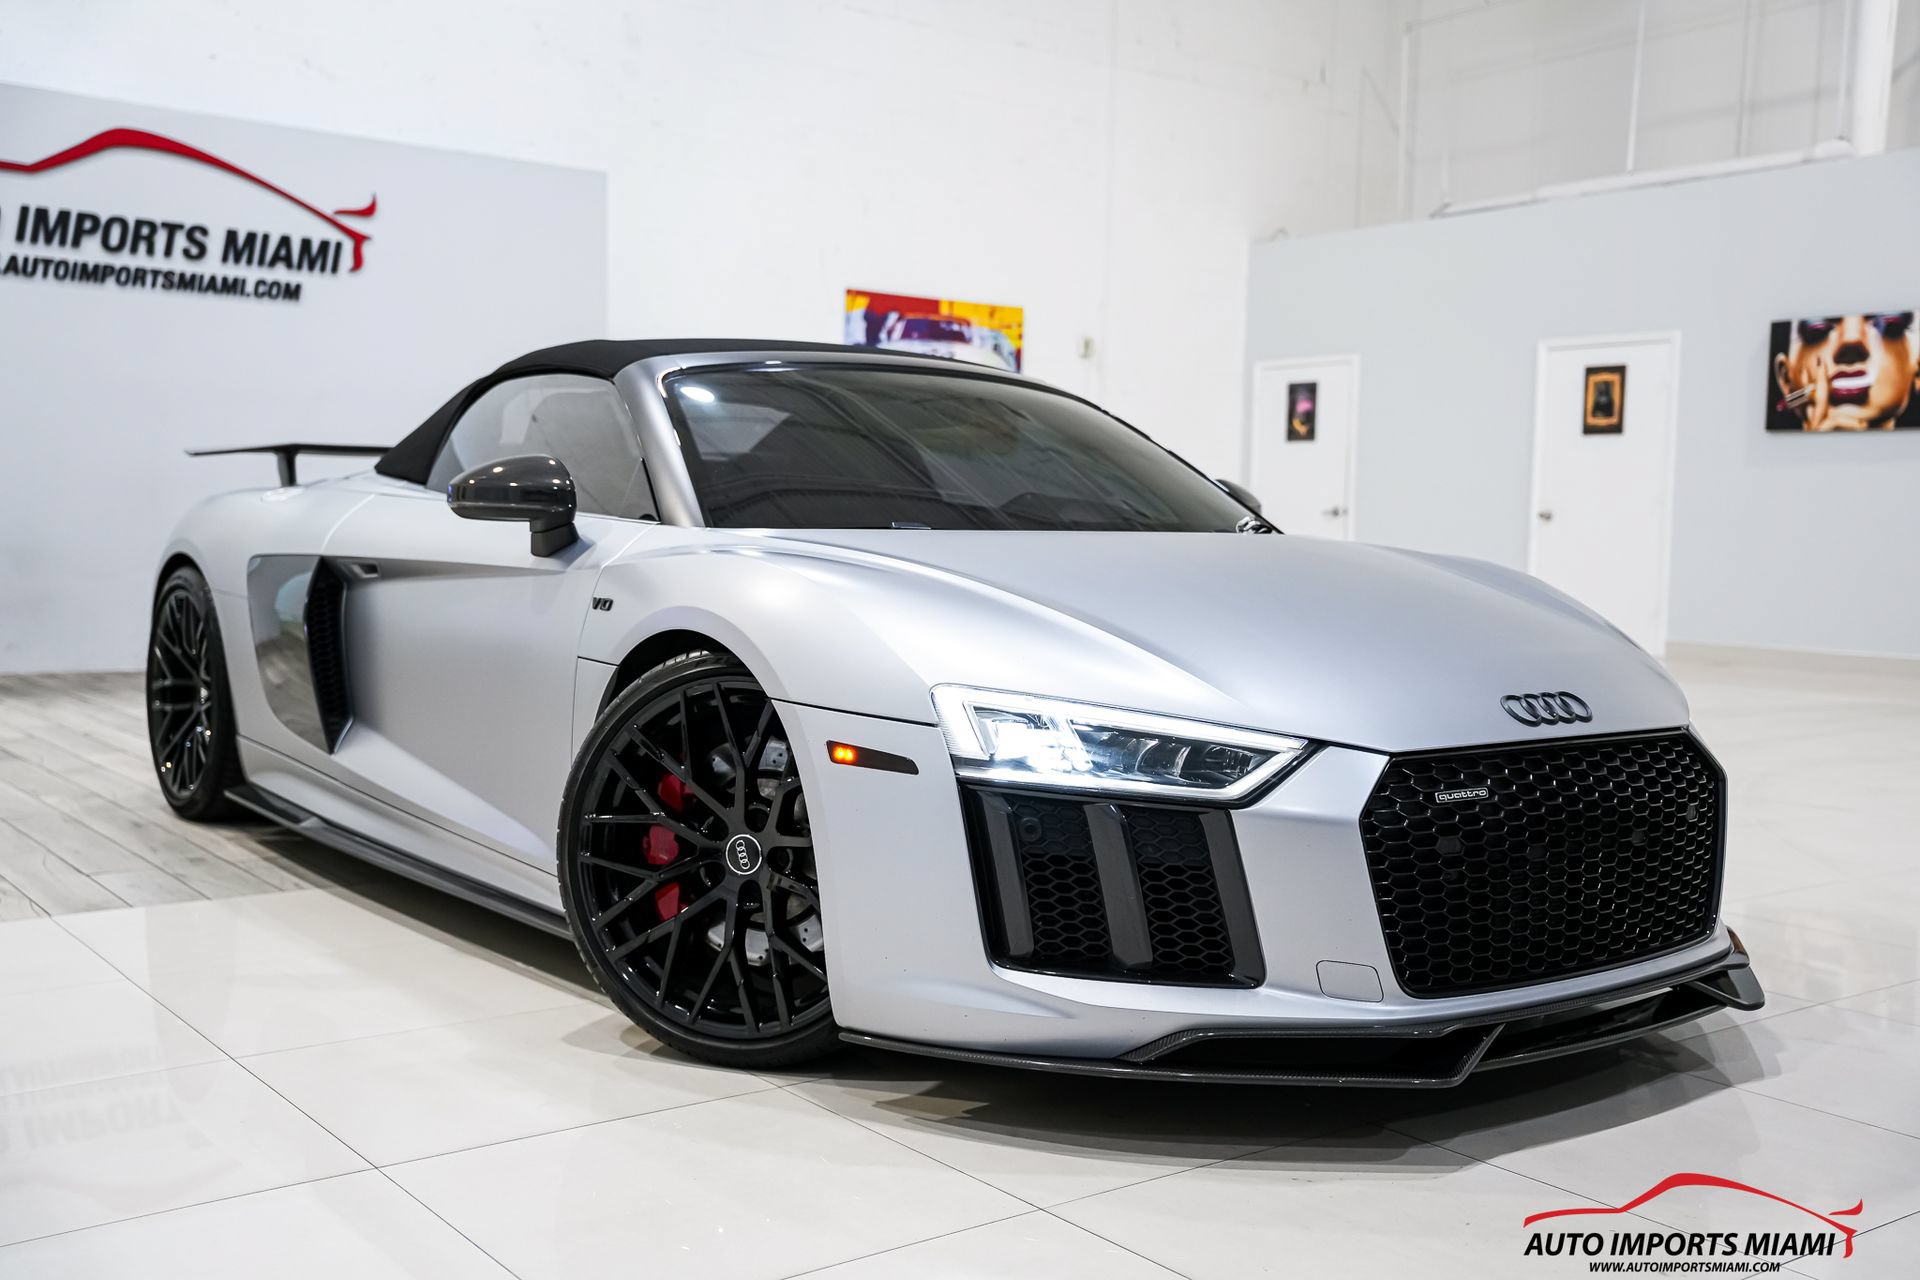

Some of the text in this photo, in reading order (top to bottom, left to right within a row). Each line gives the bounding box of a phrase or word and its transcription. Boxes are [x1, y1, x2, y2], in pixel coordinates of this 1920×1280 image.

[15, 204, 343, 275] IMPORTS MIAMI
[0, 253, 302, 301] AUTOIMPORTSMIAMI.COM
[1438, 789, 1487, 801] quattro
